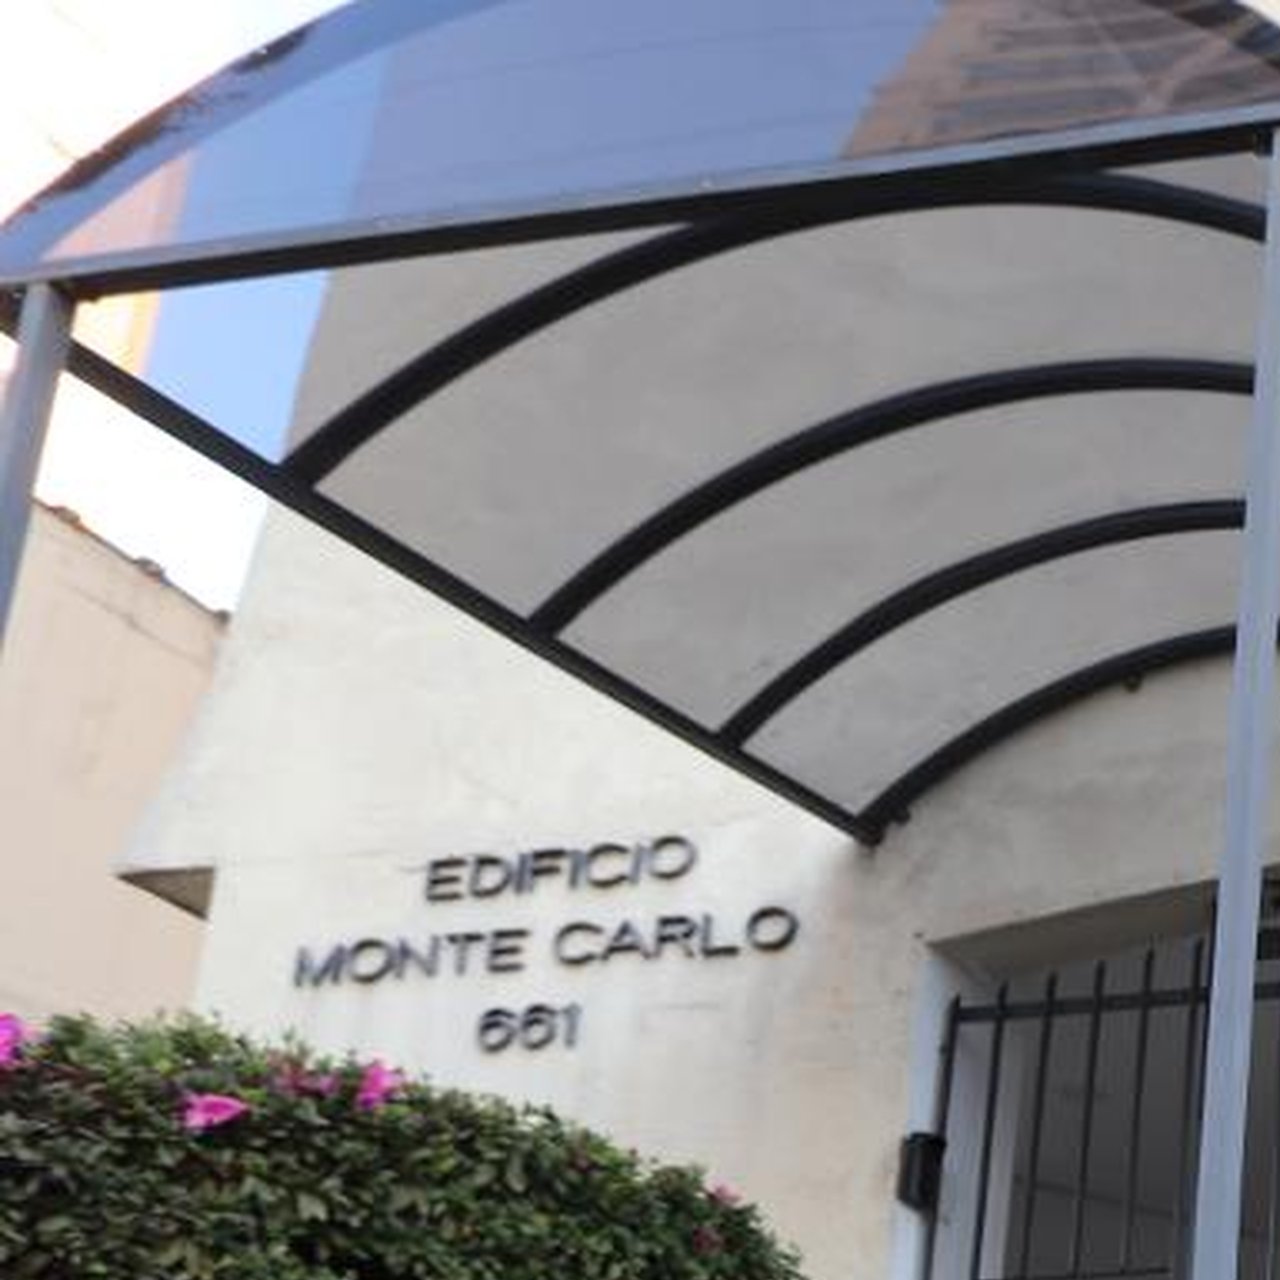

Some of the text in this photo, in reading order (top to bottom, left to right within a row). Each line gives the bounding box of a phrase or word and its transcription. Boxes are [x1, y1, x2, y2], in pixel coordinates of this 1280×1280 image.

[425, 834, 697, 903] EDIFICIO
[293, 906, 799, 988] MONTE CARLO
[477, 1002, 586, 1053] 661
